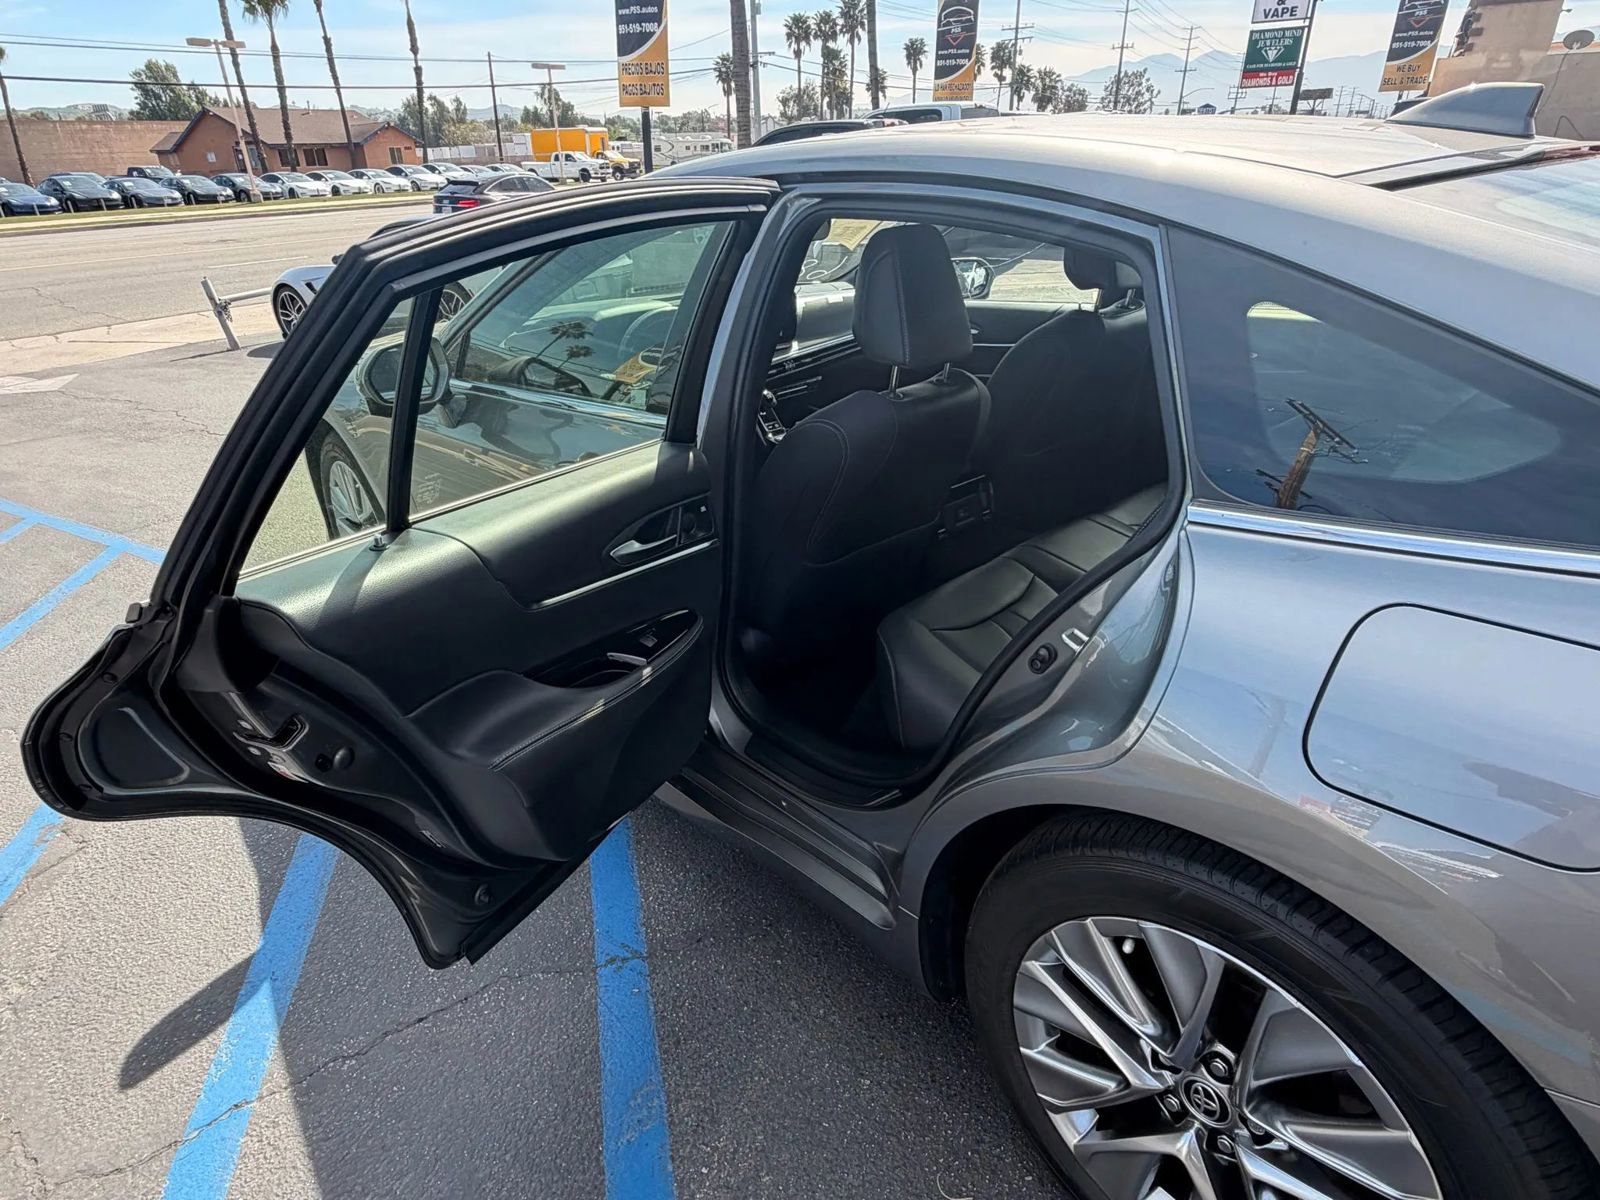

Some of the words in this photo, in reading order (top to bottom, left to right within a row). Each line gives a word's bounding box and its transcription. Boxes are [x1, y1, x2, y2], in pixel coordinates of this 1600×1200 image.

[618, 5, 658, 15] www.PSS.autos
[1263, 6, 1299, 19] VAPE
[618, 22, 659, 34] 951-519-7008
[1252, 30, 1284, 40] DIAMOND
[1284, 29, 1302, 38] MIND
[1256, 38, 1294, 48] JEWELERS
[622, 62, 644, 75] PRECIOS
[644, 62, 665, 75] BAJOS
[1396, 64, 1407, 73] WE
[1407, 64, 1421, 72] BUY
[1241, 77, 1271, 87] DIAMONDS
[1271, 76, 1277, 85] &
[1277, 75, 1294, 85] GOLD
[1383, 77, 1397, 86] SELL
[1399, 77, 1404, 85] &
[1406, 76, 1428, 84] TRADE
[622, 83, 640, 96] PAGOS
[640, 83, 665, 96] BAJITOS
